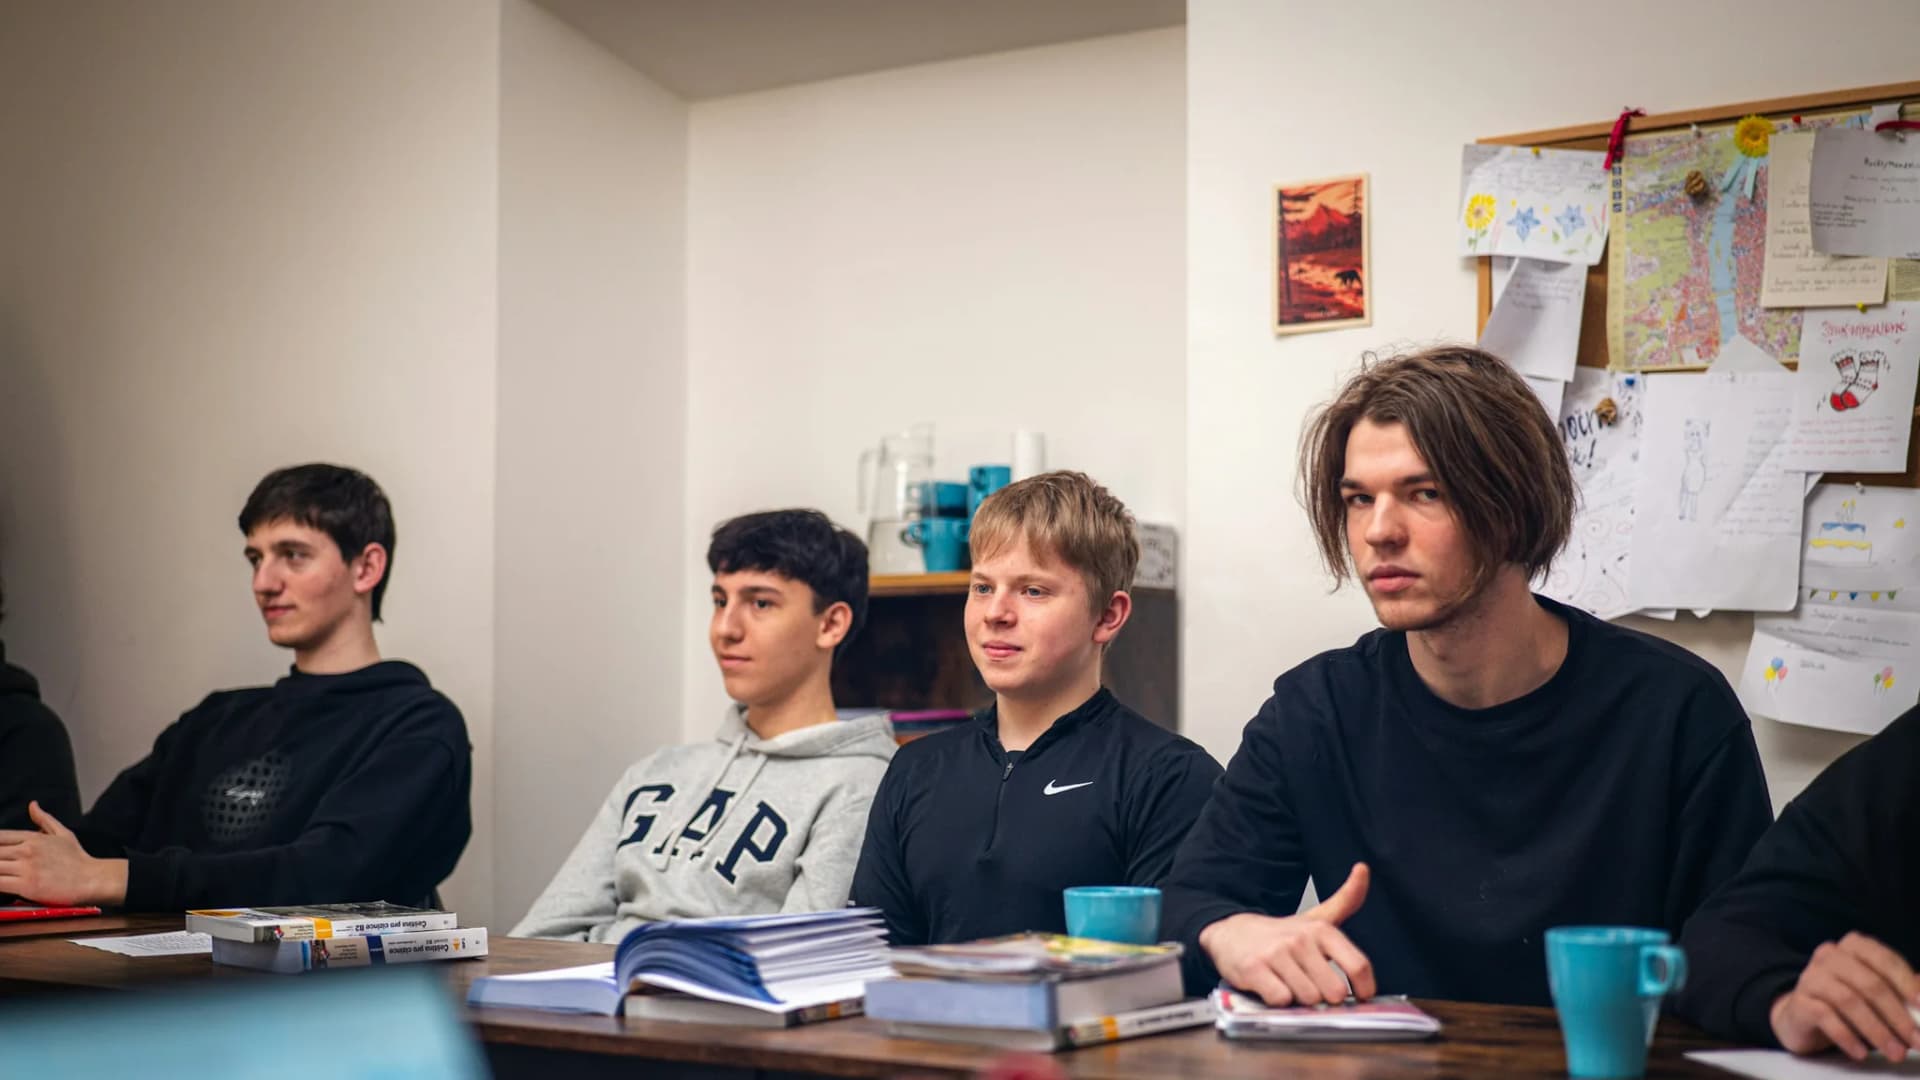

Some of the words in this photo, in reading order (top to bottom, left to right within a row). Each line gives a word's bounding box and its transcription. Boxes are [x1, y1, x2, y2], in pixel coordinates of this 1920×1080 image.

[616, 784, 788, 885] GAP
[355, 924, 365, 932] B2
[366, 923, 389, 931] cizince
[390, 921, 401, 930] pro
[413, 944, 424, 953] pro
